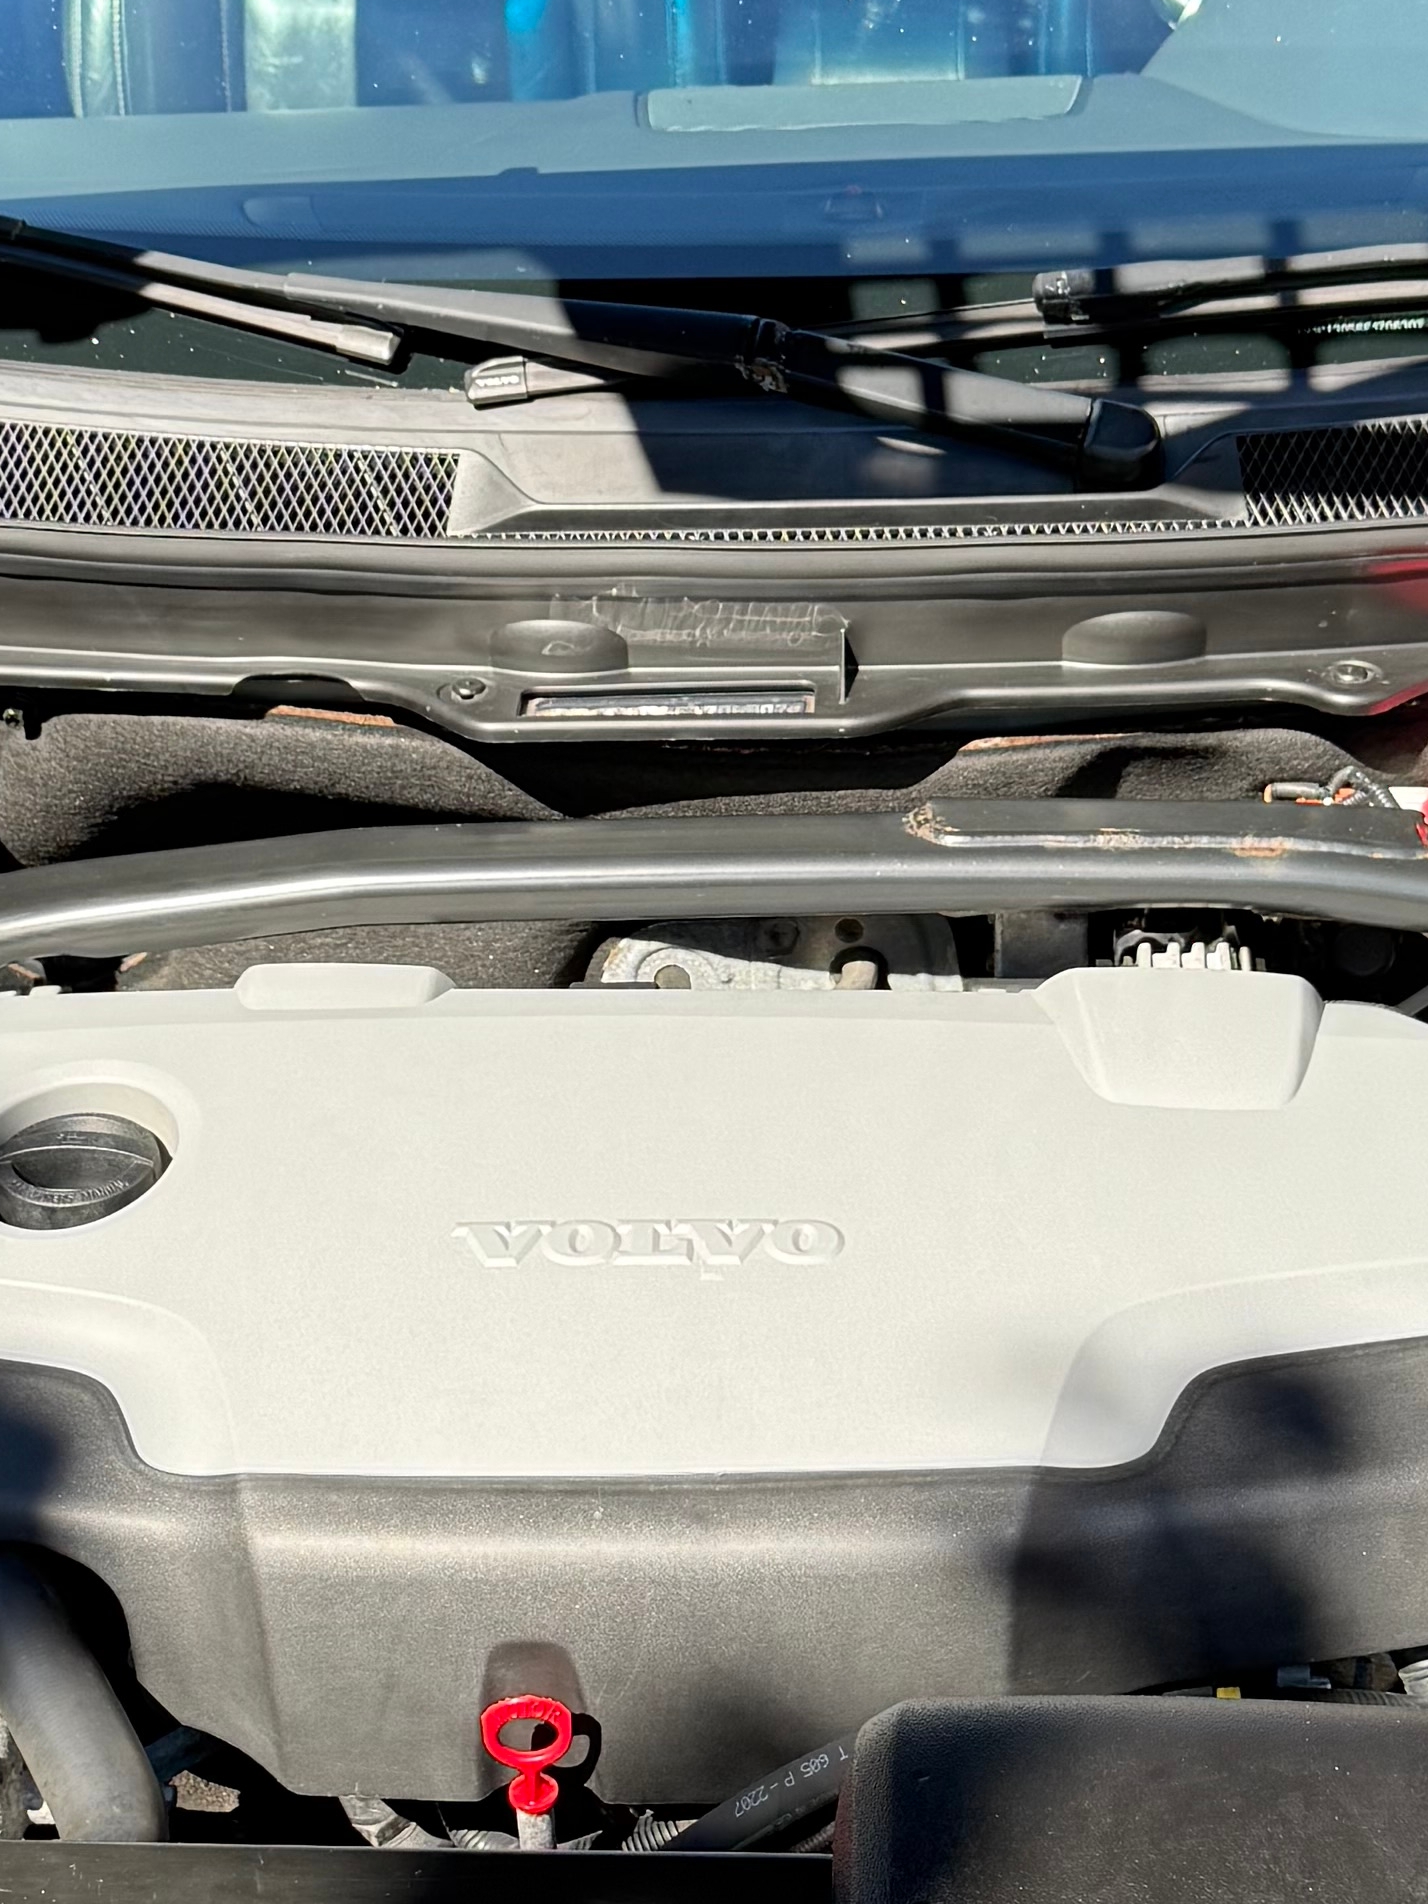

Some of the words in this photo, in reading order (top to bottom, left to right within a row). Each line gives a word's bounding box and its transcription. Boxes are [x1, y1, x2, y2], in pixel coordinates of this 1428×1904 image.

[451, 1218, 846, 1268] VOLVO
[800, 1753, 829, 1778] 605
[838, 1745, 849, 1761] T
[784, 1771, 795, 1787] P
[734, 1785, 768, 1817] 2207
